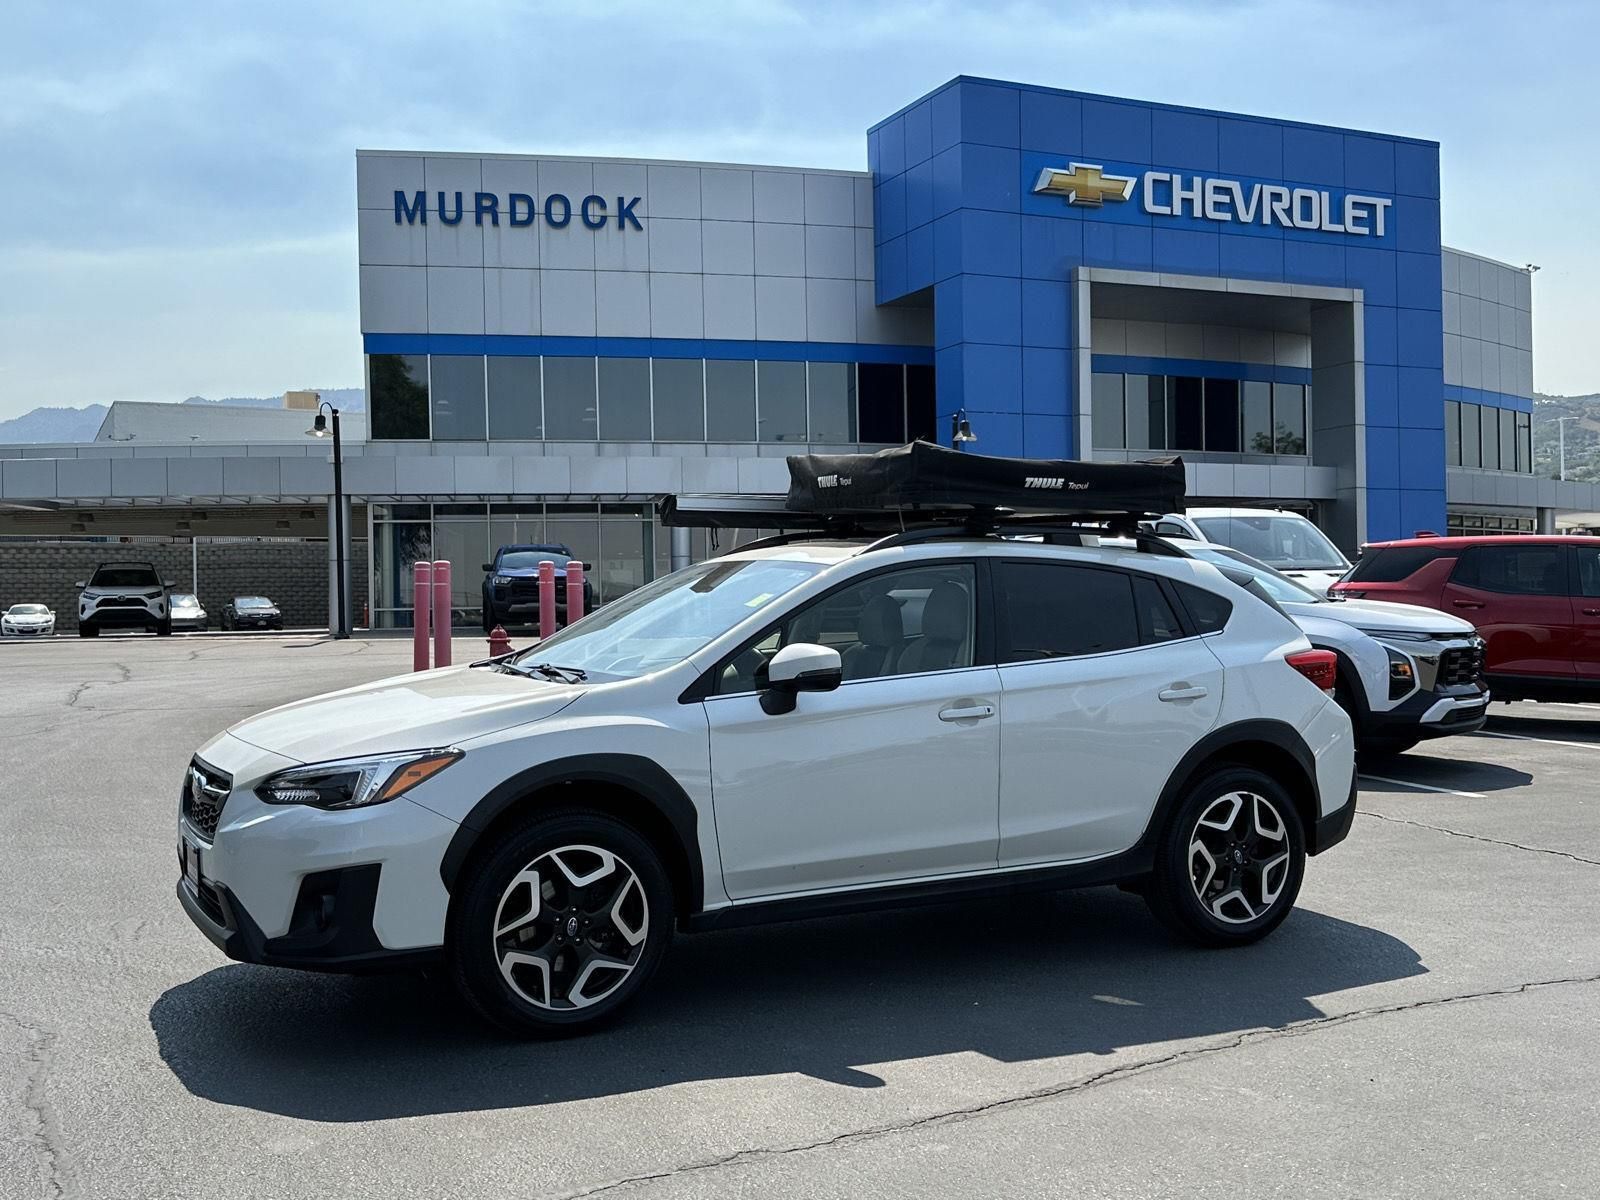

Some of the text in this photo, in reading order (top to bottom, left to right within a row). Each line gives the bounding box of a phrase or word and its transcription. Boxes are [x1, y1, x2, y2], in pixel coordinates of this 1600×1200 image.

[394, 190, 644, 231] MURDOCK
[1143, 171, 1392, 236] CHEVROLET
[817, 474, 838, 488] THULE
[1024, 477, 1065, 489] THULE
